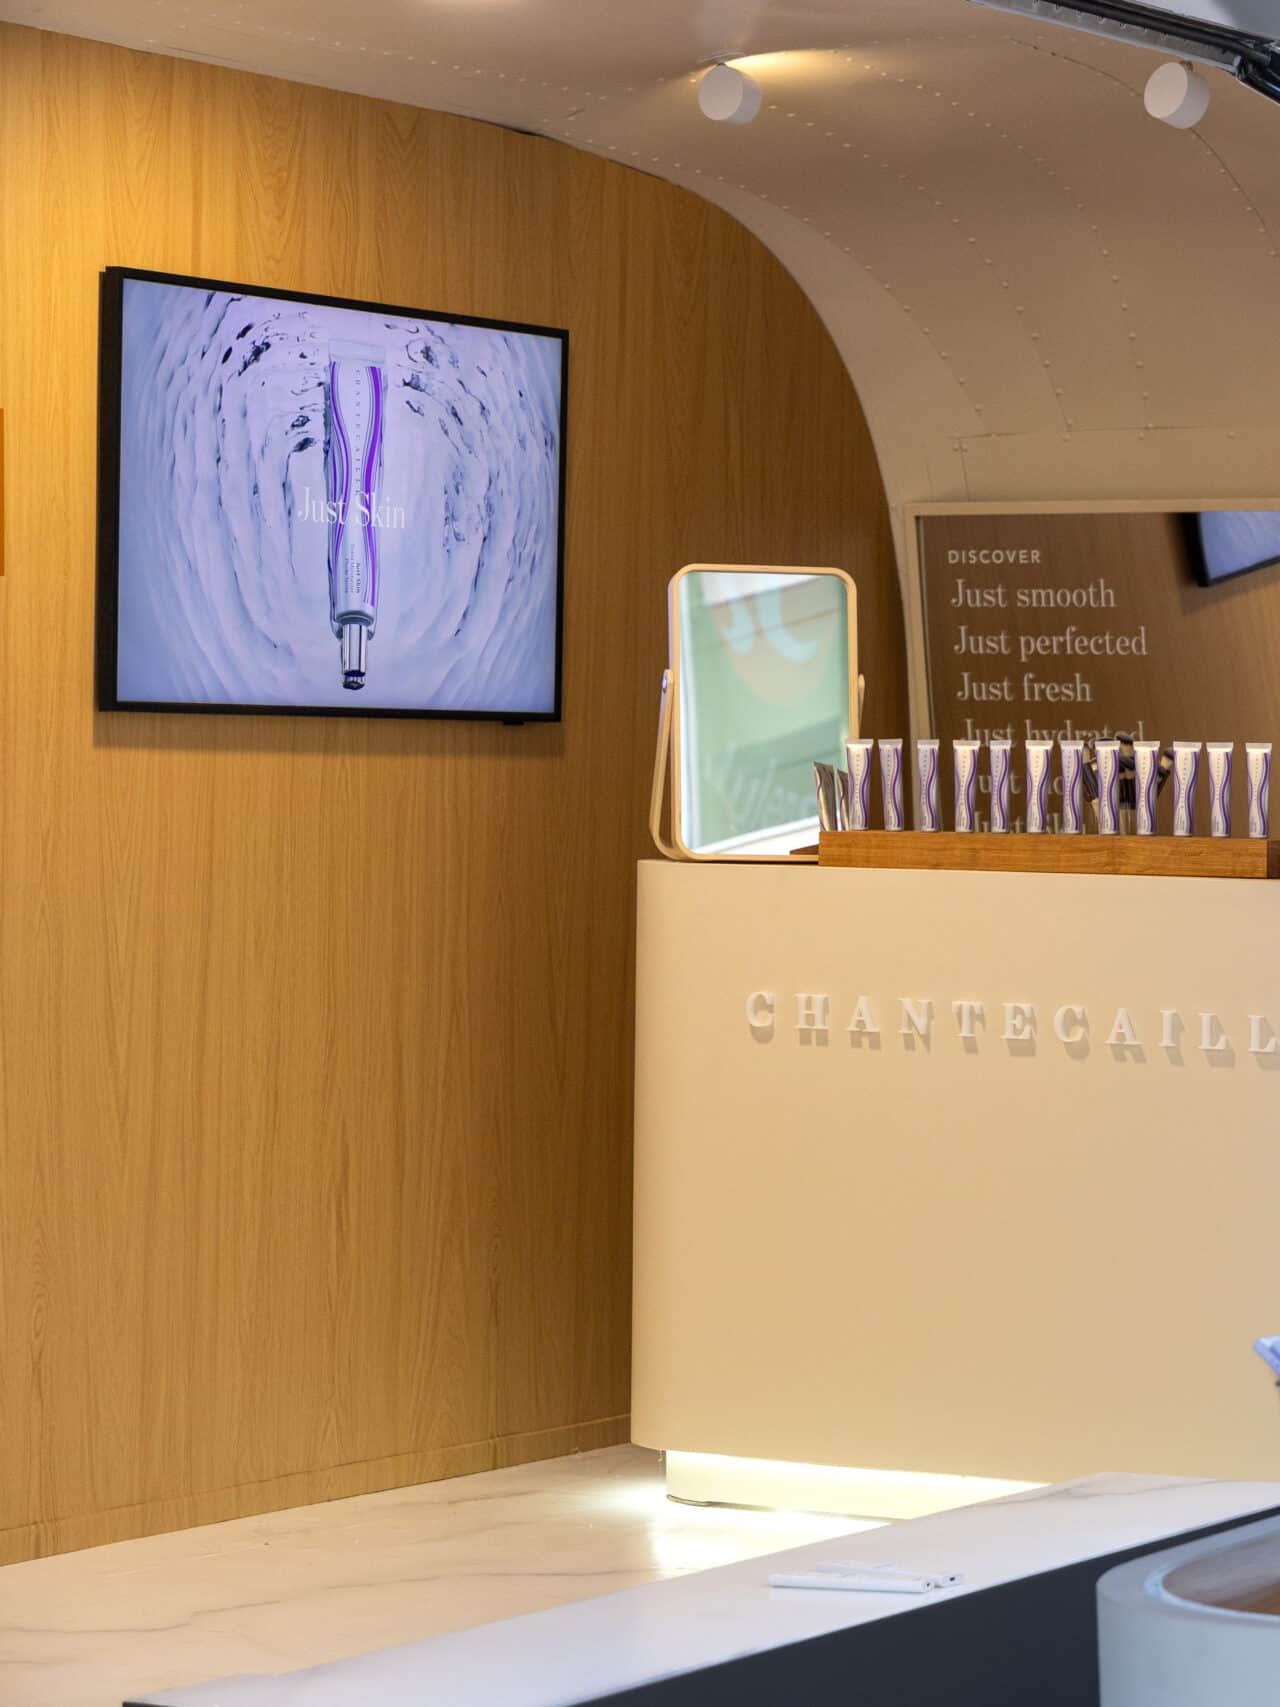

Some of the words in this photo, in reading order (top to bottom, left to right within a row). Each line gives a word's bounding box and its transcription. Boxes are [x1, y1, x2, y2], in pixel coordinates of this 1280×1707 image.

[297, 486, 345, 524] Just
[354, 490, 405, 529] Skin
[948, 550, 1041, 564] DISCOVER
[951, 578, 1007, 608] Just
[1016, 578, 1116, 609] smooth
[953, 625, 1010, 655] Just
[1019, 626, 1149, 662] perfected
[956, 672, 1013, 702] Just
[1022, 673, 1093, 702] fresh
[960, 719, 1017, 747] Just
